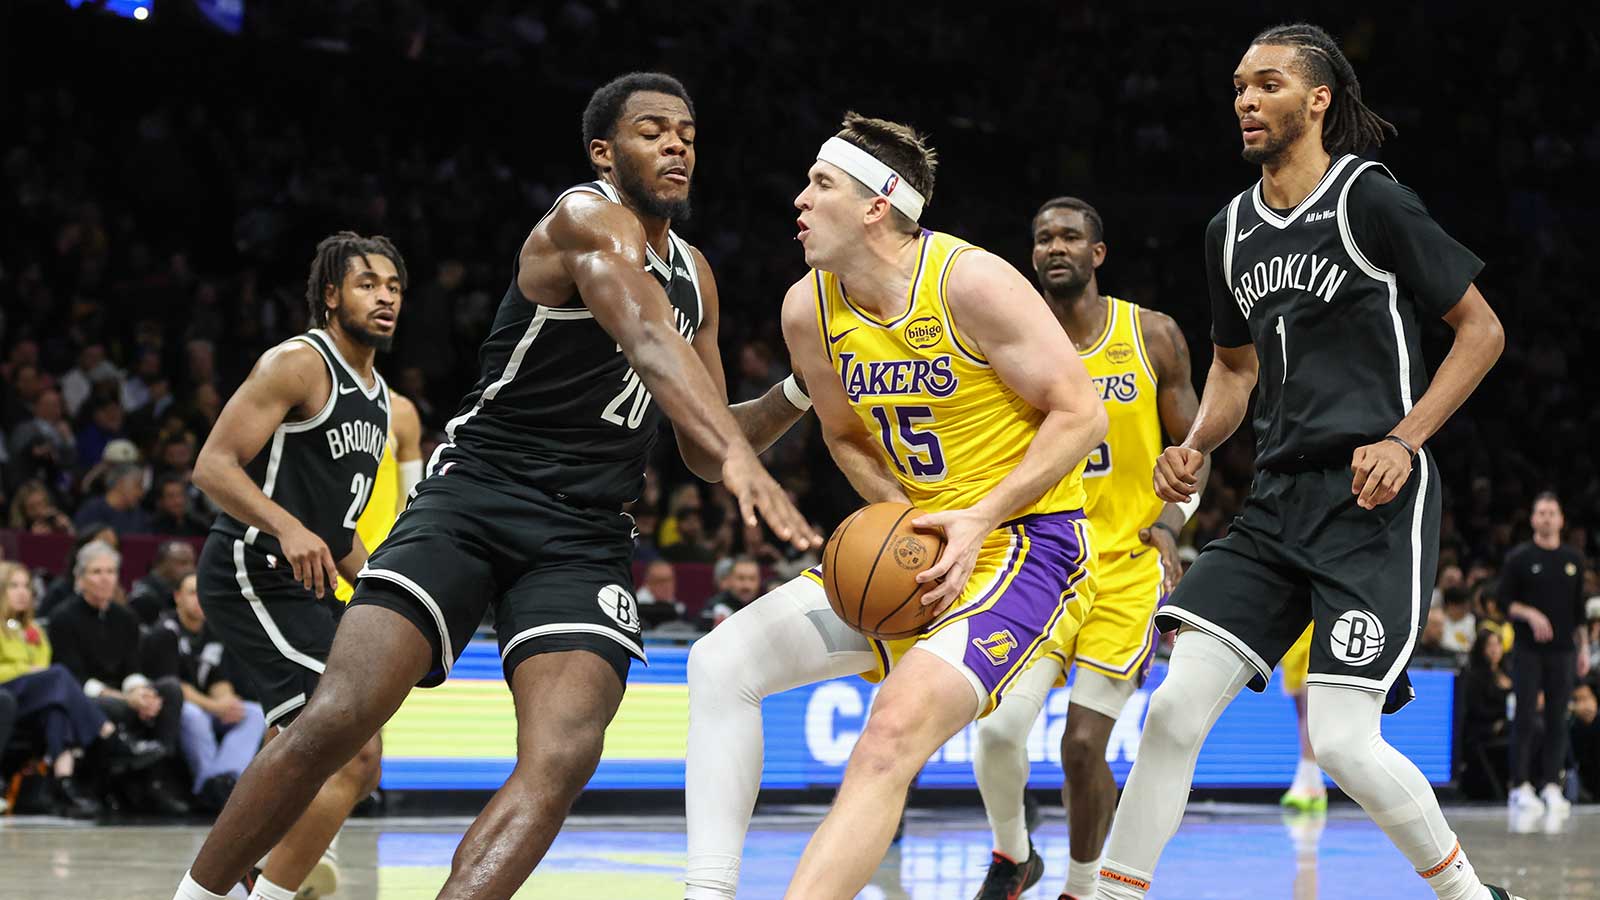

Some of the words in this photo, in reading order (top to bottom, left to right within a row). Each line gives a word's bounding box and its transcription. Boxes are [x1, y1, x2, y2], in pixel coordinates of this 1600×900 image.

[1234, 253, 1348, 320] BROOKLYN
[908, 325, 941, 338] bibigo
[1275, 316, 1288, 385] 1
[601, 367, 653, 430] 20
[839, 352, 959, 403] LAKERS
[871, 405, 948, 483] 15
